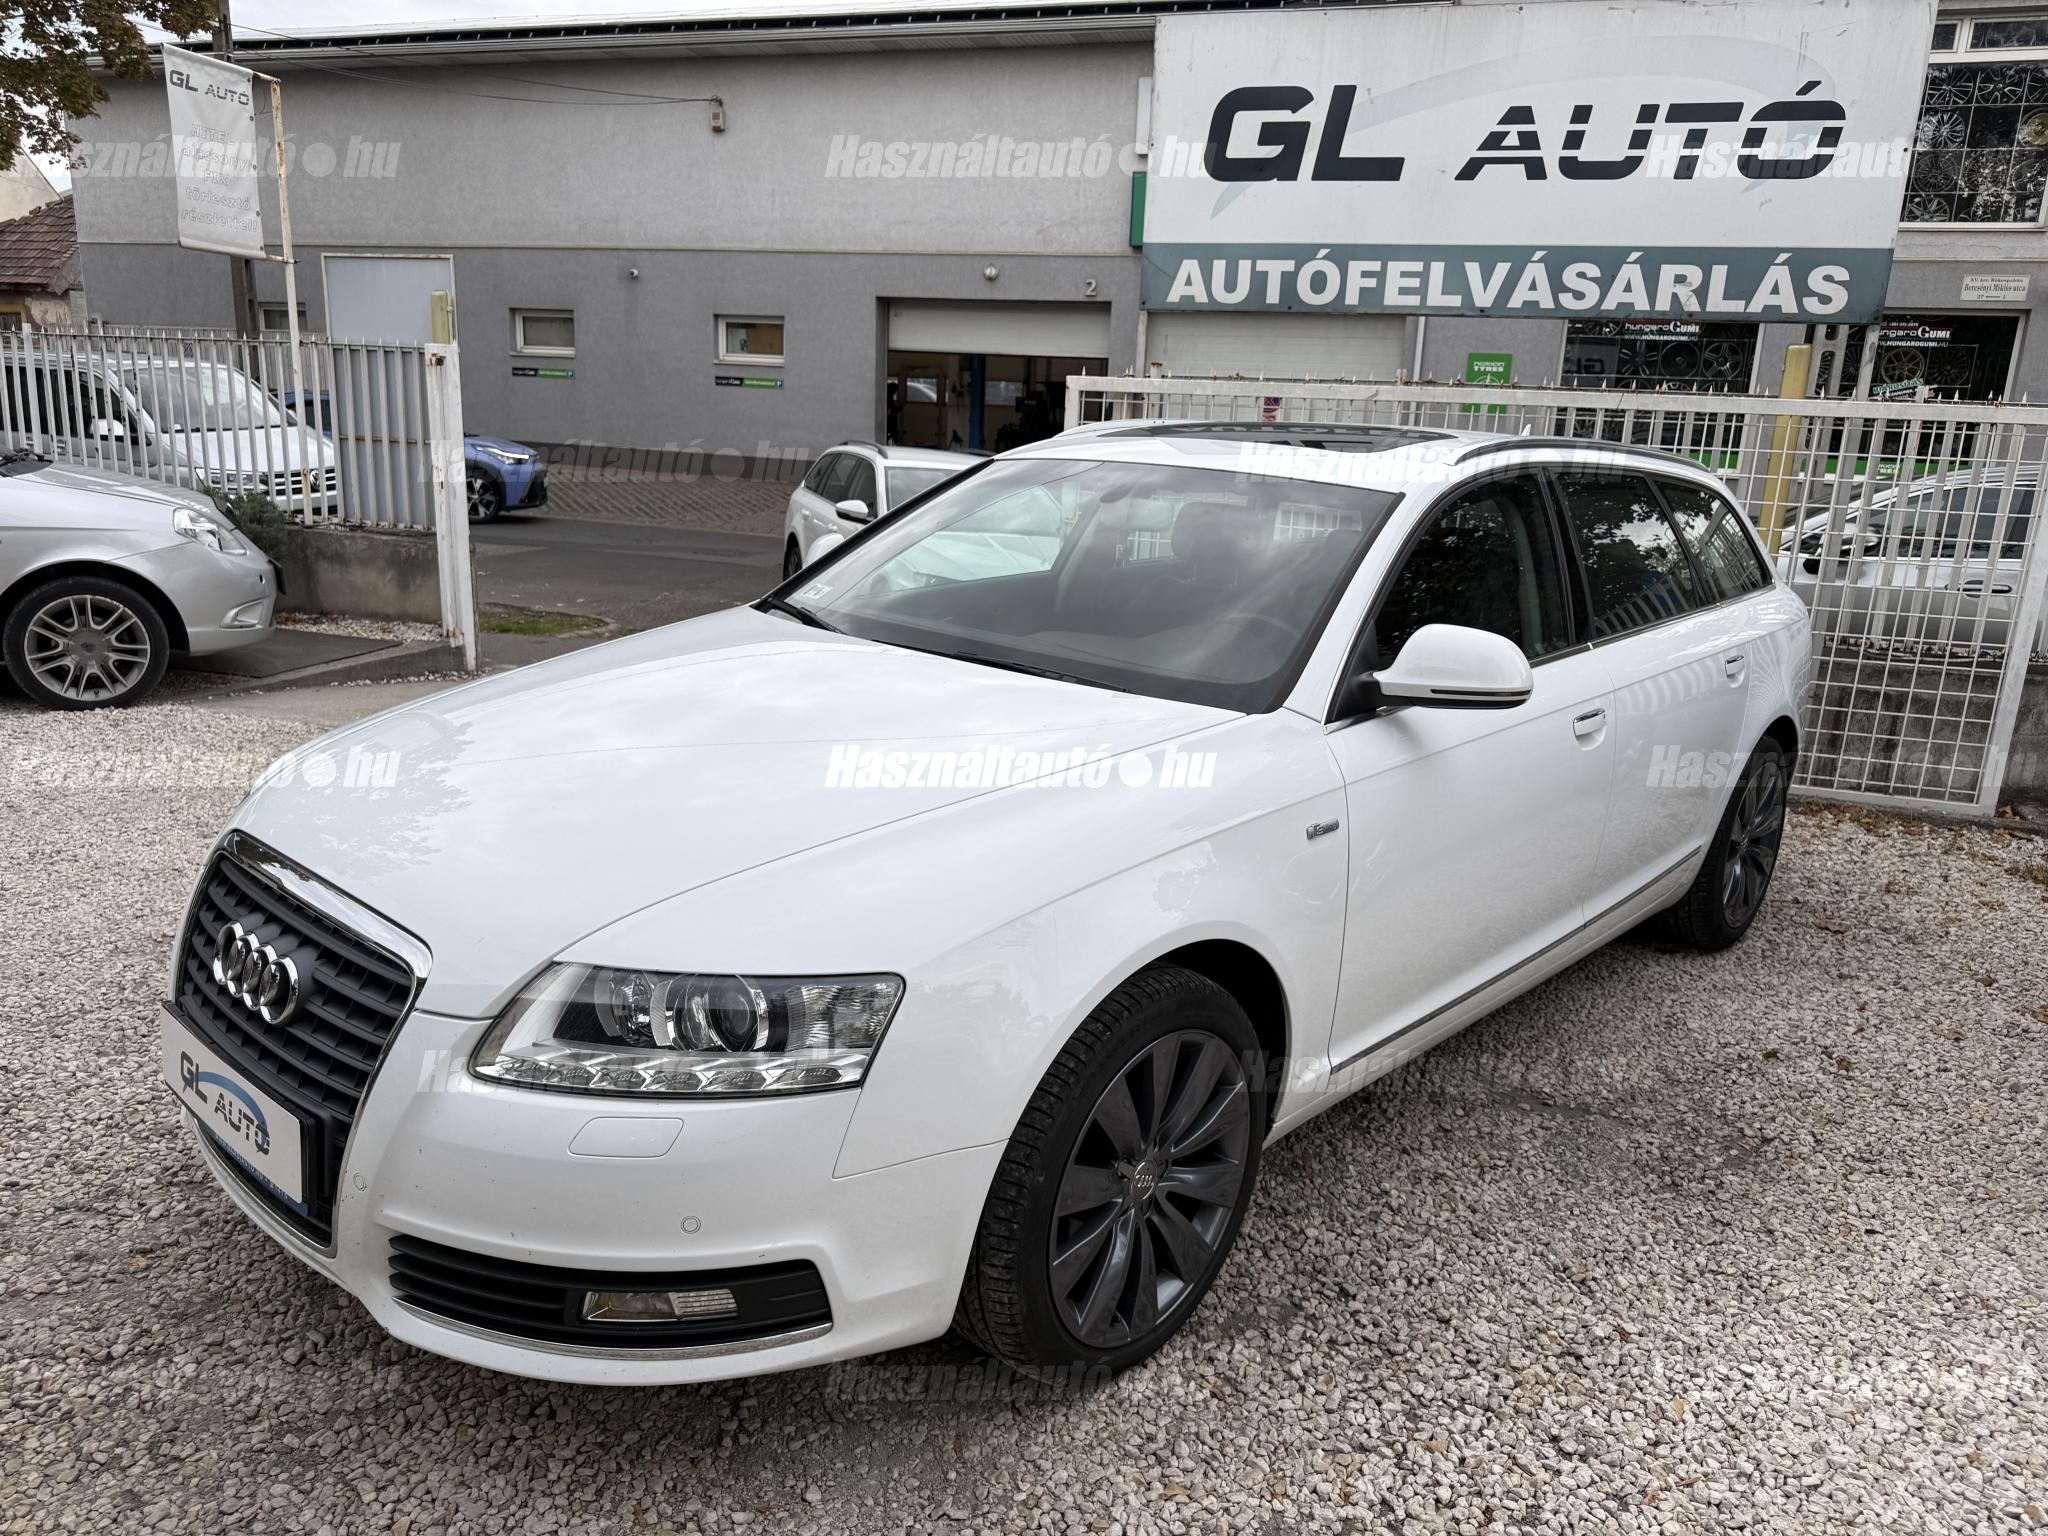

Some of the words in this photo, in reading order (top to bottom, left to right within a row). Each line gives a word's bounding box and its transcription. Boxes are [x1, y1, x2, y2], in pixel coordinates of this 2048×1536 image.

[169, 69, 199, 92] GL
[205, 84, 250, 106] AUTÓ
[191, 123, 233, 146] HITEL
[1203, 84, 1405, 182] GL
[1454, 80, 1846, 181] AUTÓ
[1085, 279, 1097, 296] 2
[1166, 248, 1851, 314] AUTÓFELVÁSÁRLÁS
[180, 1050, 208, 1105] GL
